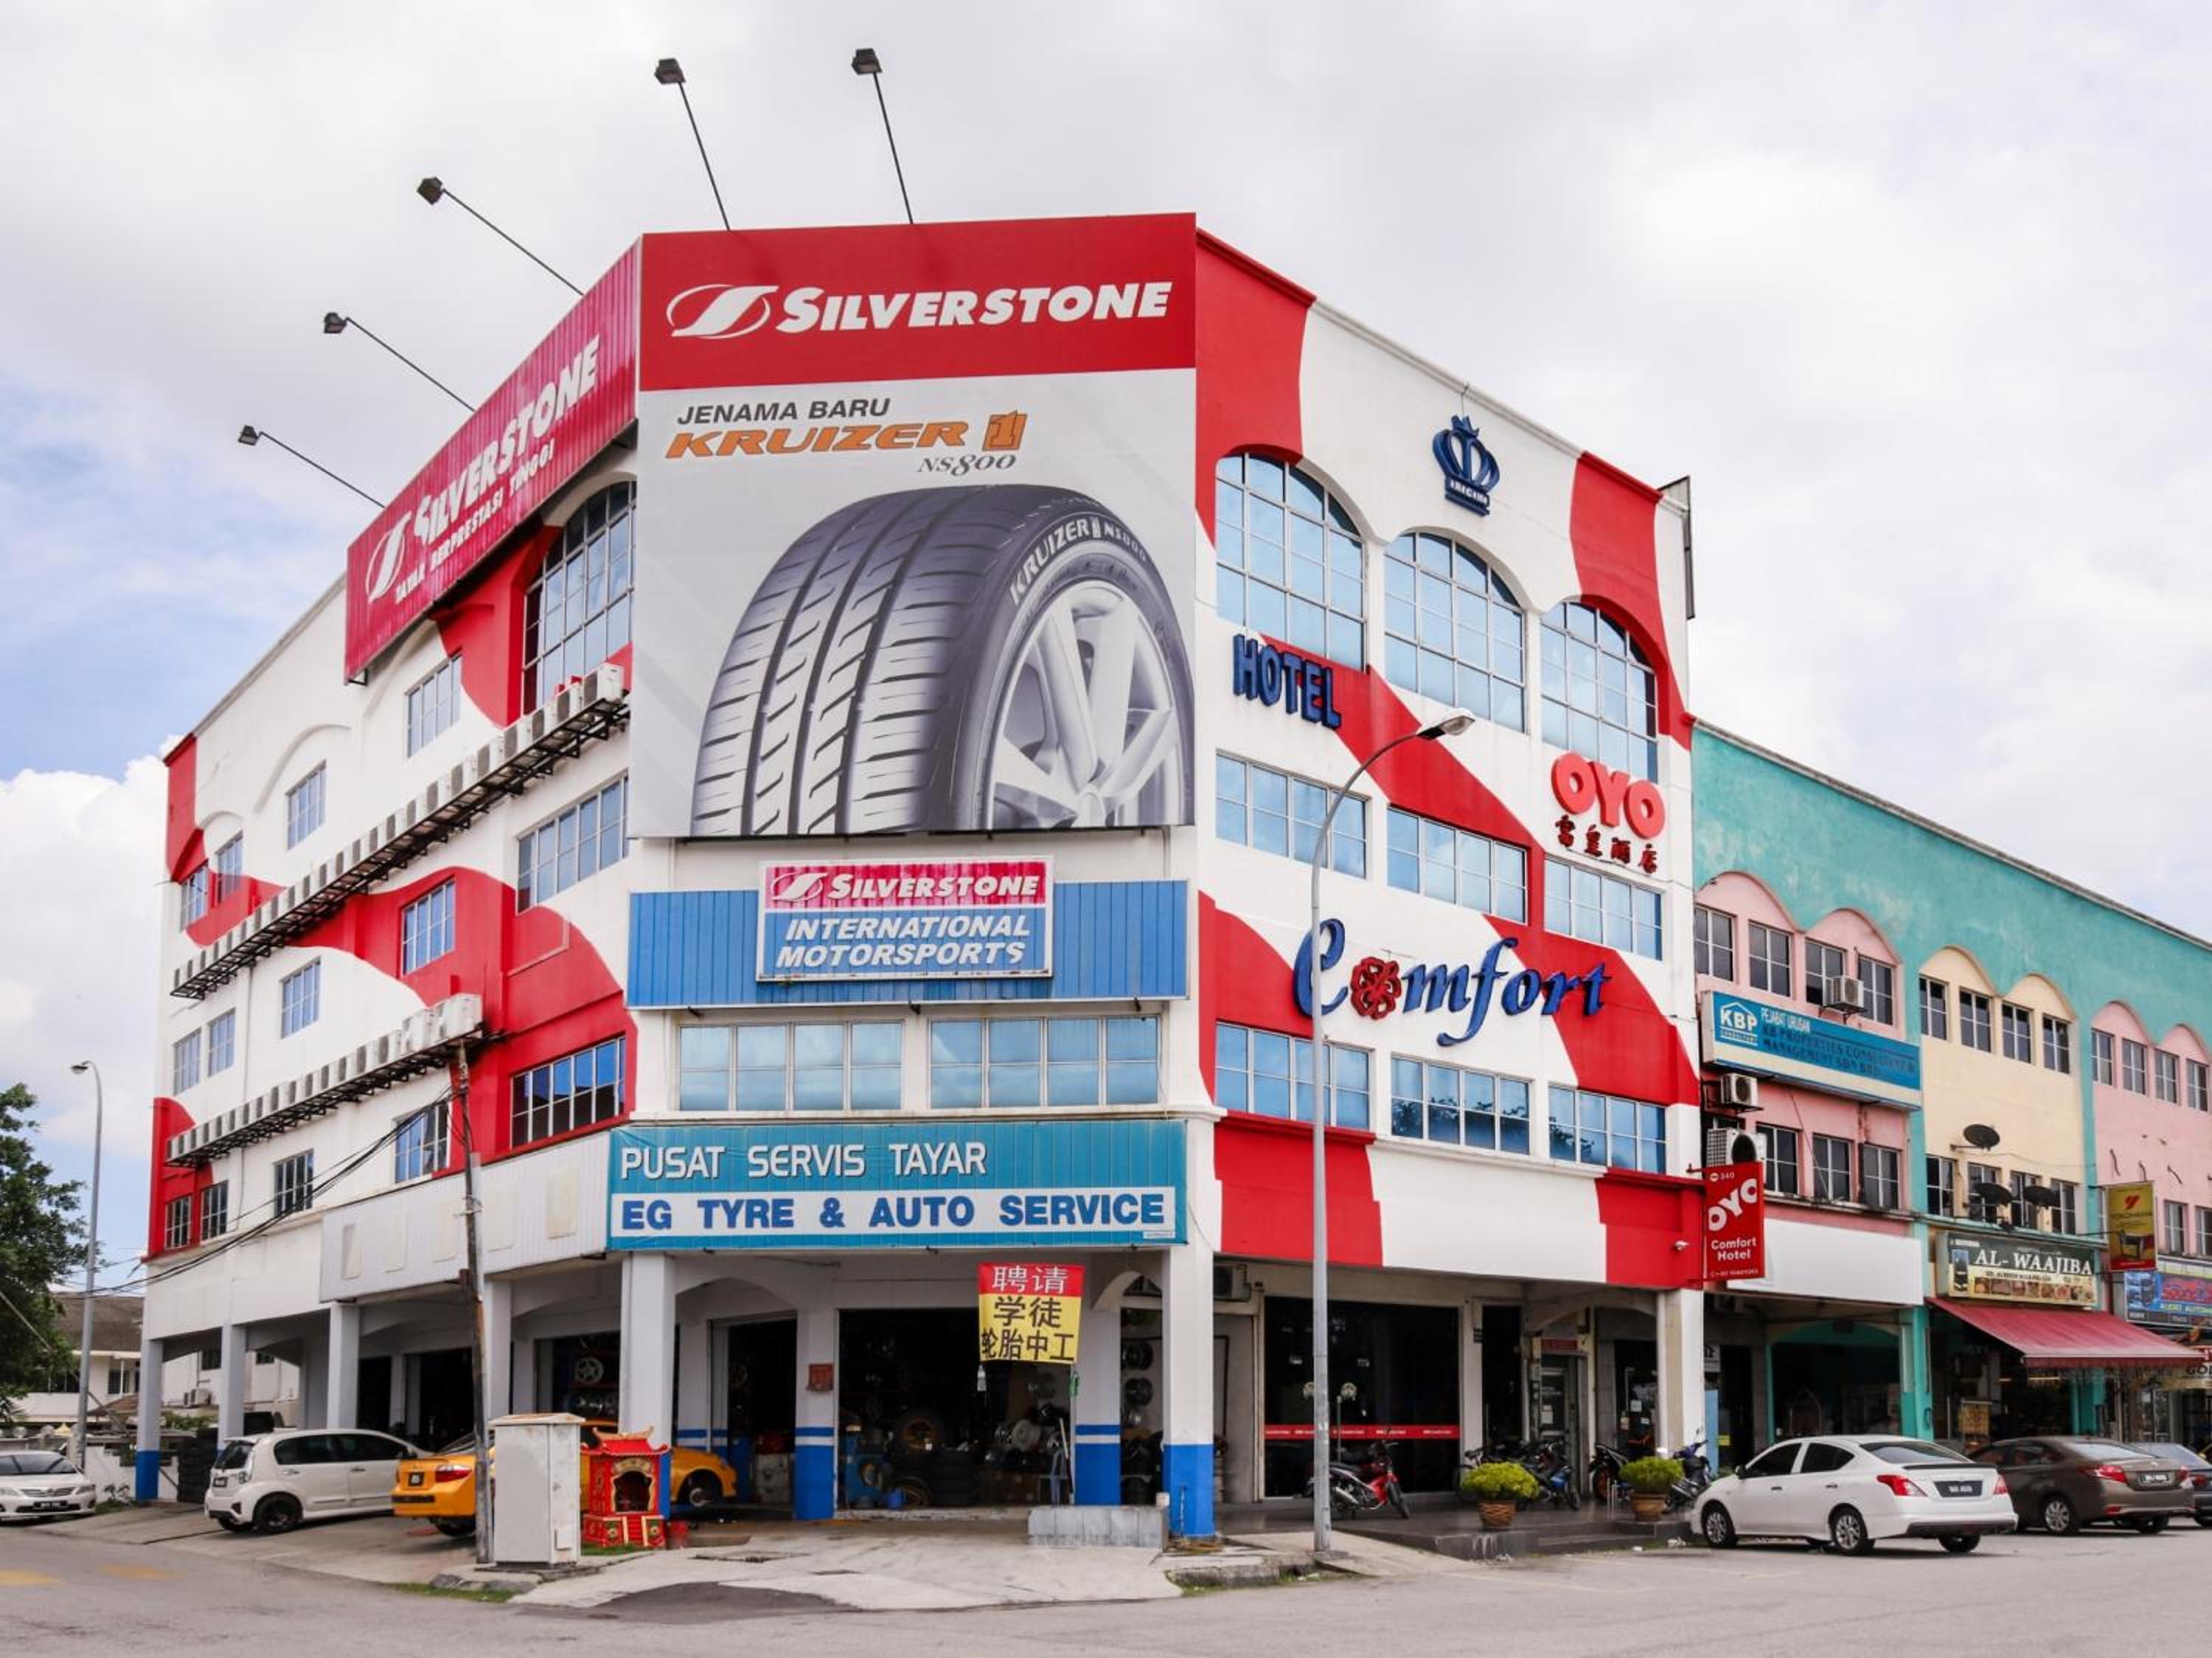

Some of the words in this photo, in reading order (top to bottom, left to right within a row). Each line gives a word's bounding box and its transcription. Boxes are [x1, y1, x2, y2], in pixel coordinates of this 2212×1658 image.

[775, 281, 1173, 335] SILVERSTONE
[678, 402, 799, 426] JENAMA
[807, 398, 891, 420] BARU
[414, 334, 600, 544] SILVERSTONE
[665, 421, 969, 459] KRUIZER
[981, 410, 1028, 451] 1
[917, 454, 1018, 478] NS800
[1009, 518, 1091, 606] KRUIZER
[1233, 634, 1340, 729] HOTEL
[1551, 752, 1666, 840] OYO
[828, 873, 1040, 899] SILVERSTONE
[786, 915, 1029, 941] INTERNATIONAL
[776, 941, 1025, 968] MOTORSPORTS
[1720, 1009, 1757, 1032] KBP
[621, 1145, 723, 1180] PUSAT
[748, 1143, 865, 1177] SERVIS
[888, 1142, 987, 1175] TAYAR
[621, 1200, 672, 1230] EG
[698, 1198, 794, 1229] TYRE
[819, 1198, 846, 1228] &
[869, 1196, 975, 1227] AUTO
[999, 1193, 1164, 1226] SERVICE
[1708, 1178, 1758, 1232] OYO
[1711, 1237, 1756, 1249] Comfort
[1718, 1249, 1750, 1261] Hotel
[2012, 1252, 2093, 1275] WAAJIBA
[992, 1266, 1068, 1294] 聘请
[993, 1296, 1062, 1328] 学徒
[981, 1329, 1074, 1362] 轮胎中工
